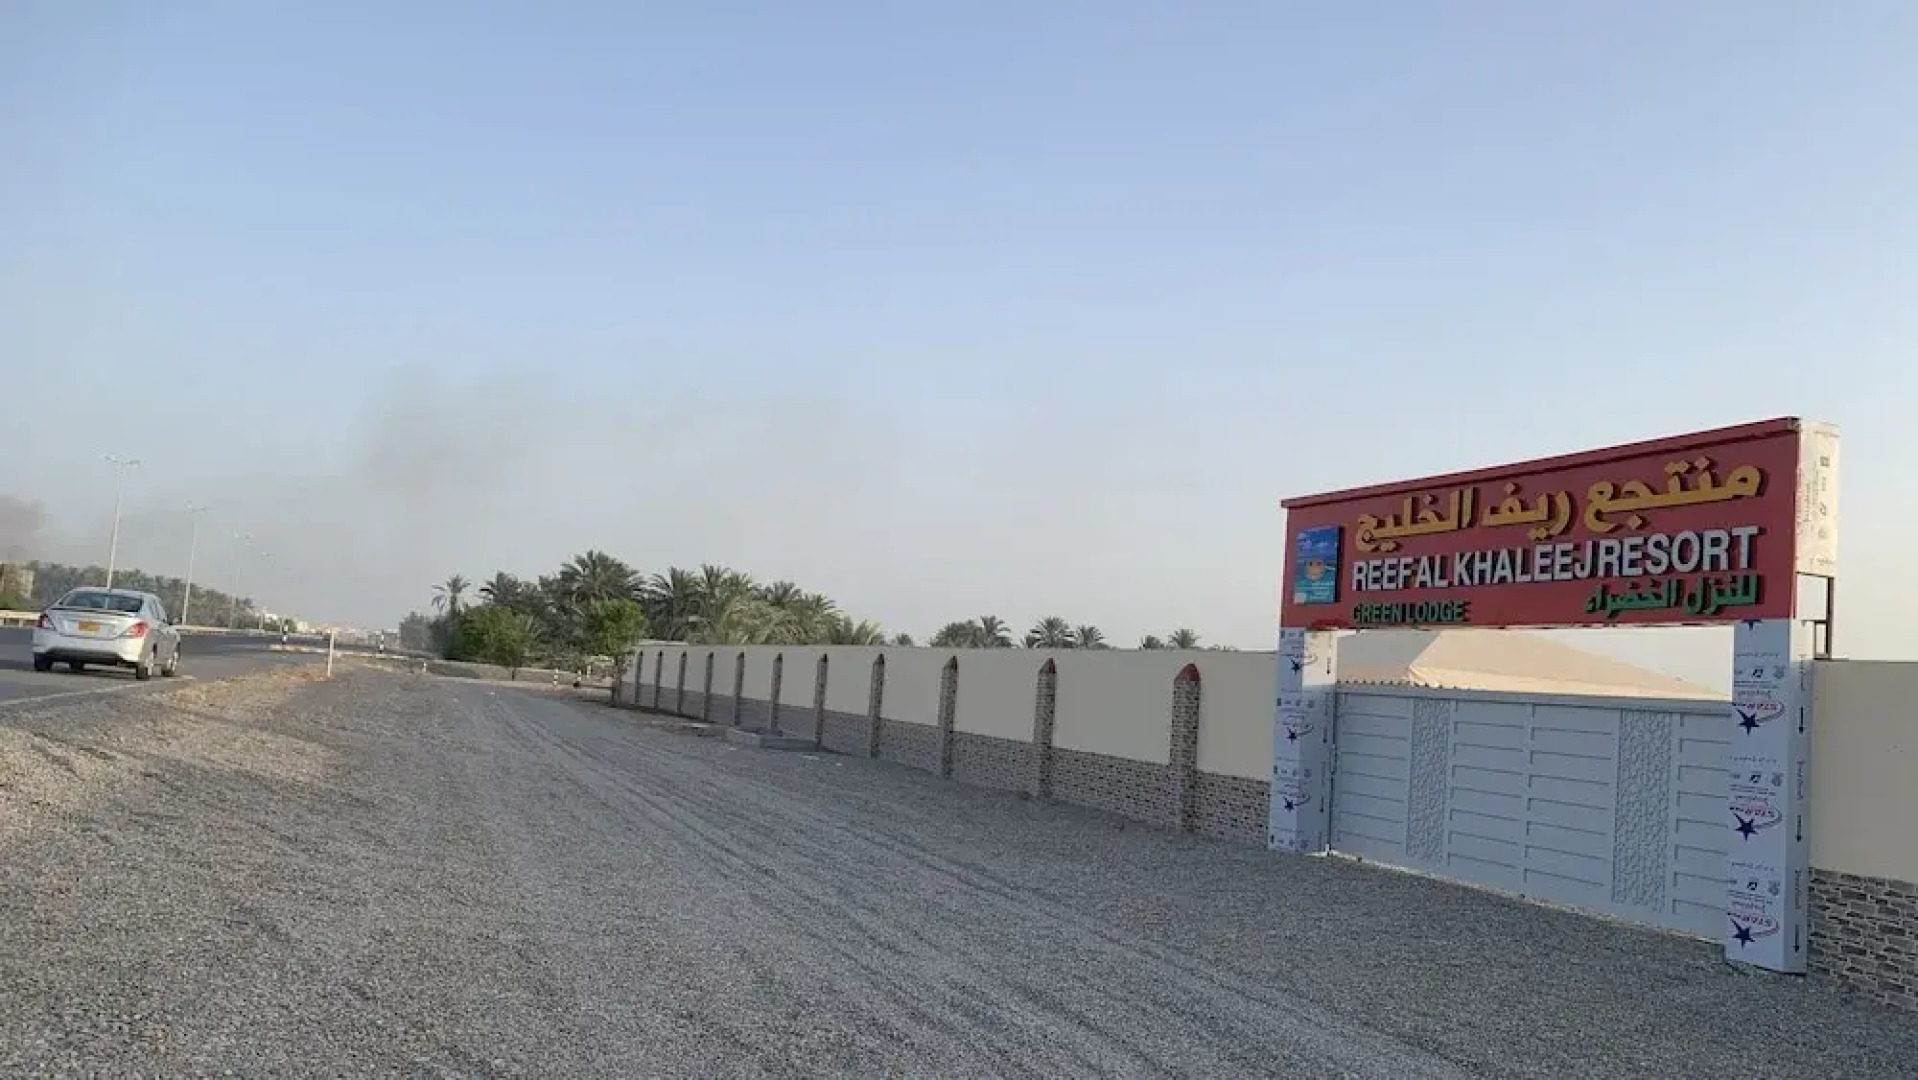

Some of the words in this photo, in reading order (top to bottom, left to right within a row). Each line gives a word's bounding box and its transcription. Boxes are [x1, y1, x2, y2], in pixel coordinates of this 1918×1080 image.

[1355, 486, 1475, 553] الخليج
[1482, 482, 1571, 540] ريف
[1583, 455, 1762, 533] منتجع
[1352, 556, 1414, 592] REEF
[1415, 553, 1450, 589] AL
[1453, 539, 1593, 587] KHALEEJ
[1597, 525, 1760, 578] RESORT
[1352, 601, 1401, 624] GREEN
[1405, 599, 1467, 623] LODGE
[1584, 577, 1679, 618] الخضراء
